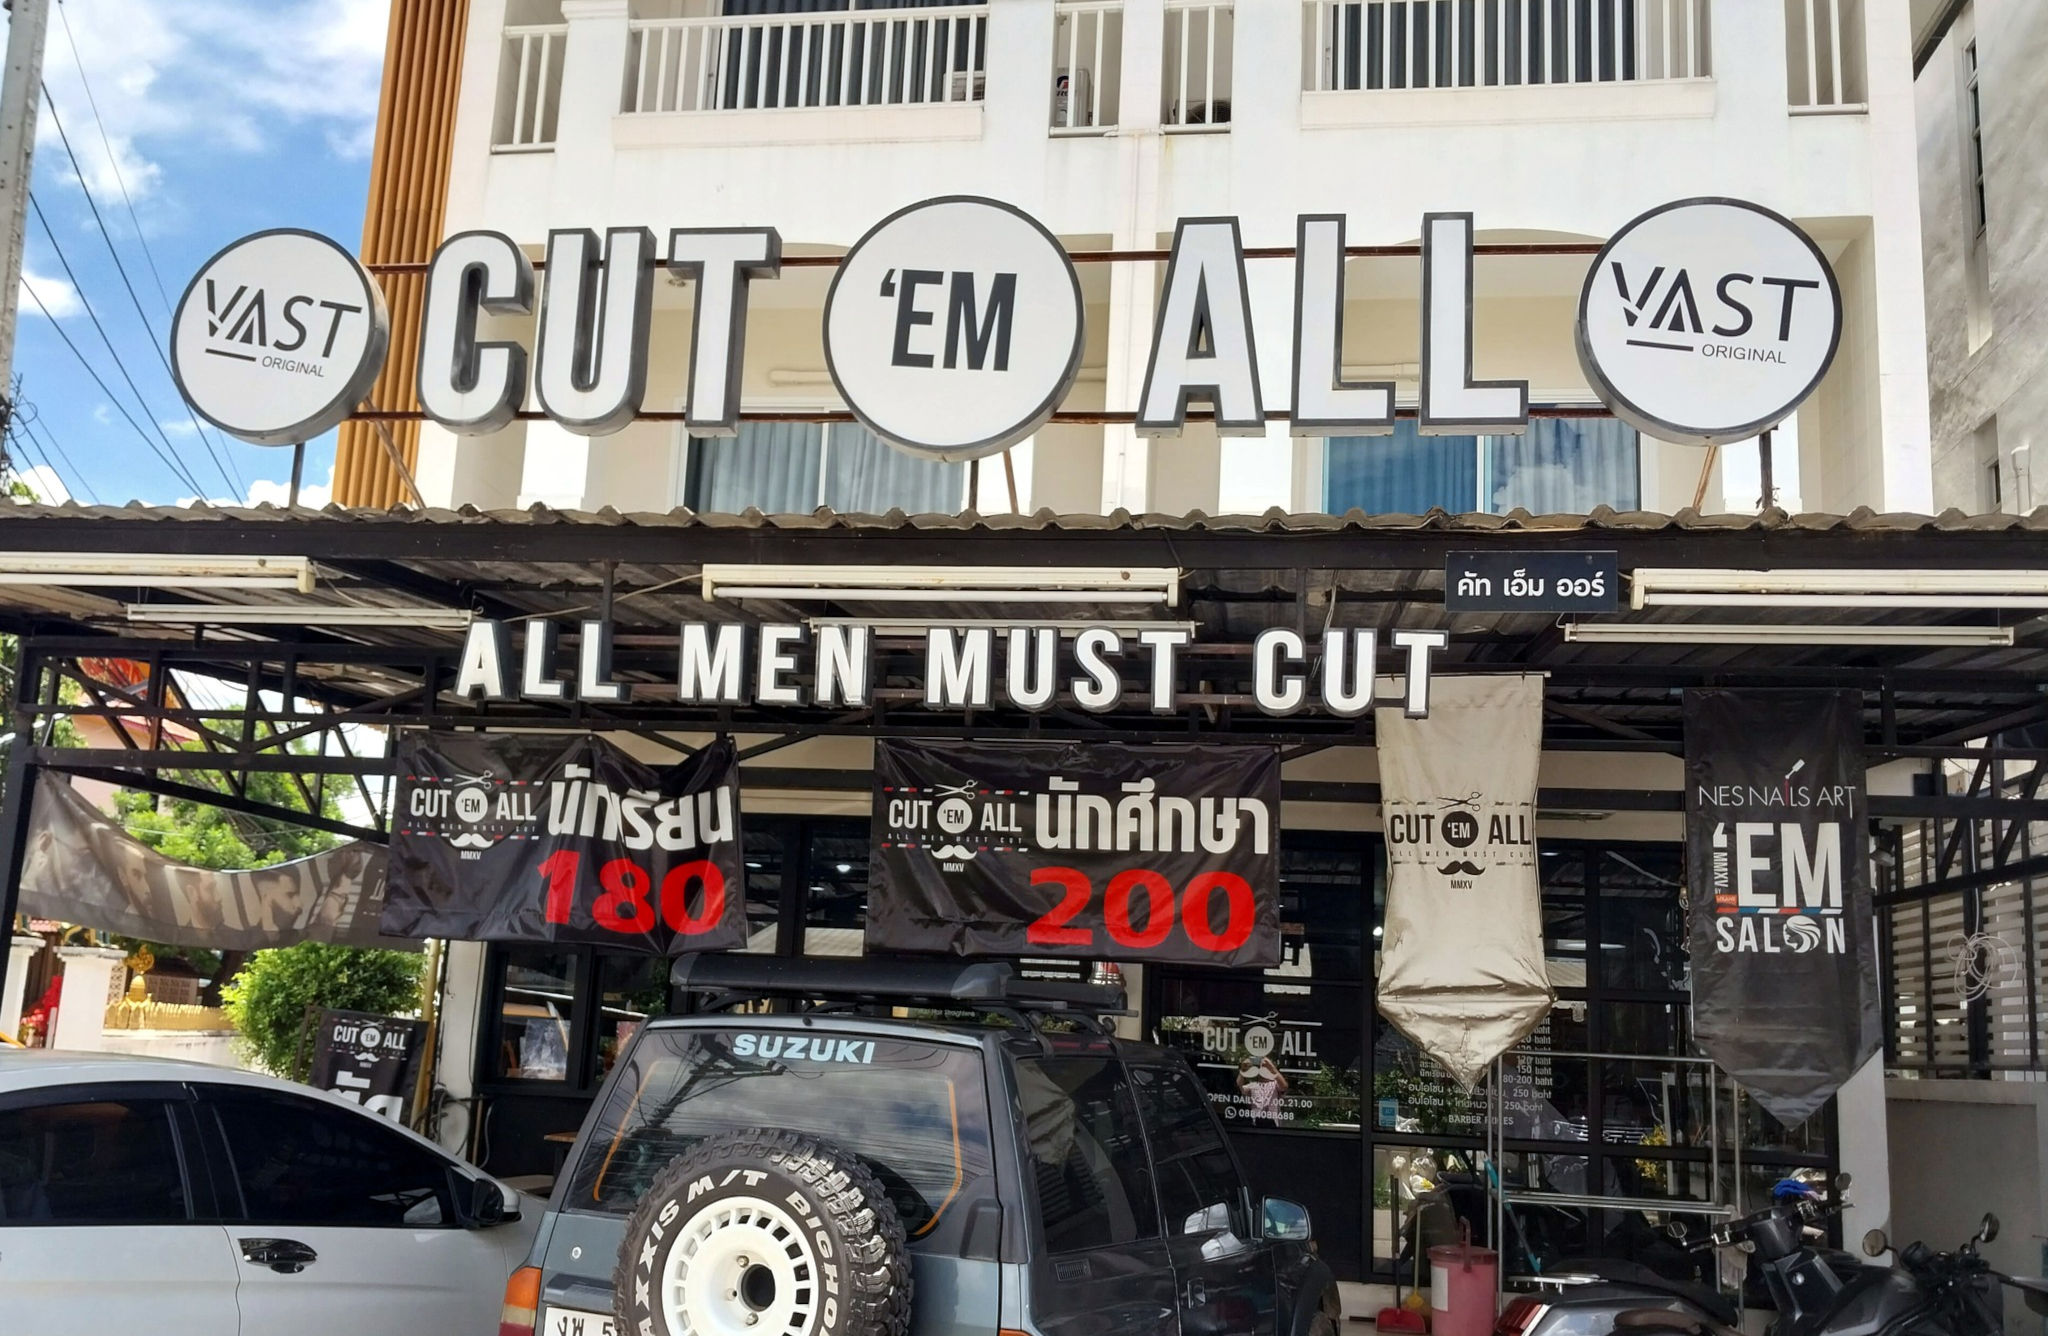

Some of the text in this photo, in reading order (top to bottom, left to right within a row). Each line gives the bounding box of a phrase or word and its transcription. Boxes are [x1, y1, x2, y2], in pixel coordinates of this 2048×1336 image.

[1611, 261, 1820, 342] VAST
[206, 278, 363, 359] VAST
[417, 213, 1530, 437] CUT 'EM ALL
[262, 355, 325, 378] ORIGINAL
[1701, 343, 1787, 364] ORIGINAL
[1457, 568, 1606, 597] คัท เอ็ม ออร์
[454, 618, 1450, 719] ALL MEN MUST CUT
[410, 787, 452, 818] CUT
[495, 792, 537, 820] ALL
[888, 799, 933, 829] CUT
[980, 802, 1023, 832] ALL
[1036, 776, 1269, 854] นักศึกษา
[1699, 785, 1744, 807] NES
[1816, 785, 1856, 819] ART
[1390, 814, 1532, 845] CUT 'EM ALL
[460, 850, 482, 861] MMXV
[942, 862, 964, 873] MMXV
[1713, 852, 1729, 888] MMXV
[537, 848, 726, 936] 180
[1450, 879, 1473, 890] MMXV
[1026, 866, 1256, 952] 200
[333, 1025, 360, 1043] CUT
[383, 1032, 406, 1050] ALL
[732, 1033, 875, 1064] SUZUKI
[1203, 1026, 1240, 1052] CUT
[1281, 1031, 1317, 1057] ALL
[1516, 1064, 1552, 1075] 150 baht
[1534, 1057, 1551, 1065] baht
[1513, 1088, 1529, 1098] 250
[1531, 1089, 1552, 1099] baht
[1535, 1076, 1553, 1086] baht
[1208, 1093, 1231, 1103] OPEN
[1504, 1101, 1520, 1110] 250
[1448, 1114, 1481, 1125] BARBER
[687, 1169, 769, 1204] M/T
